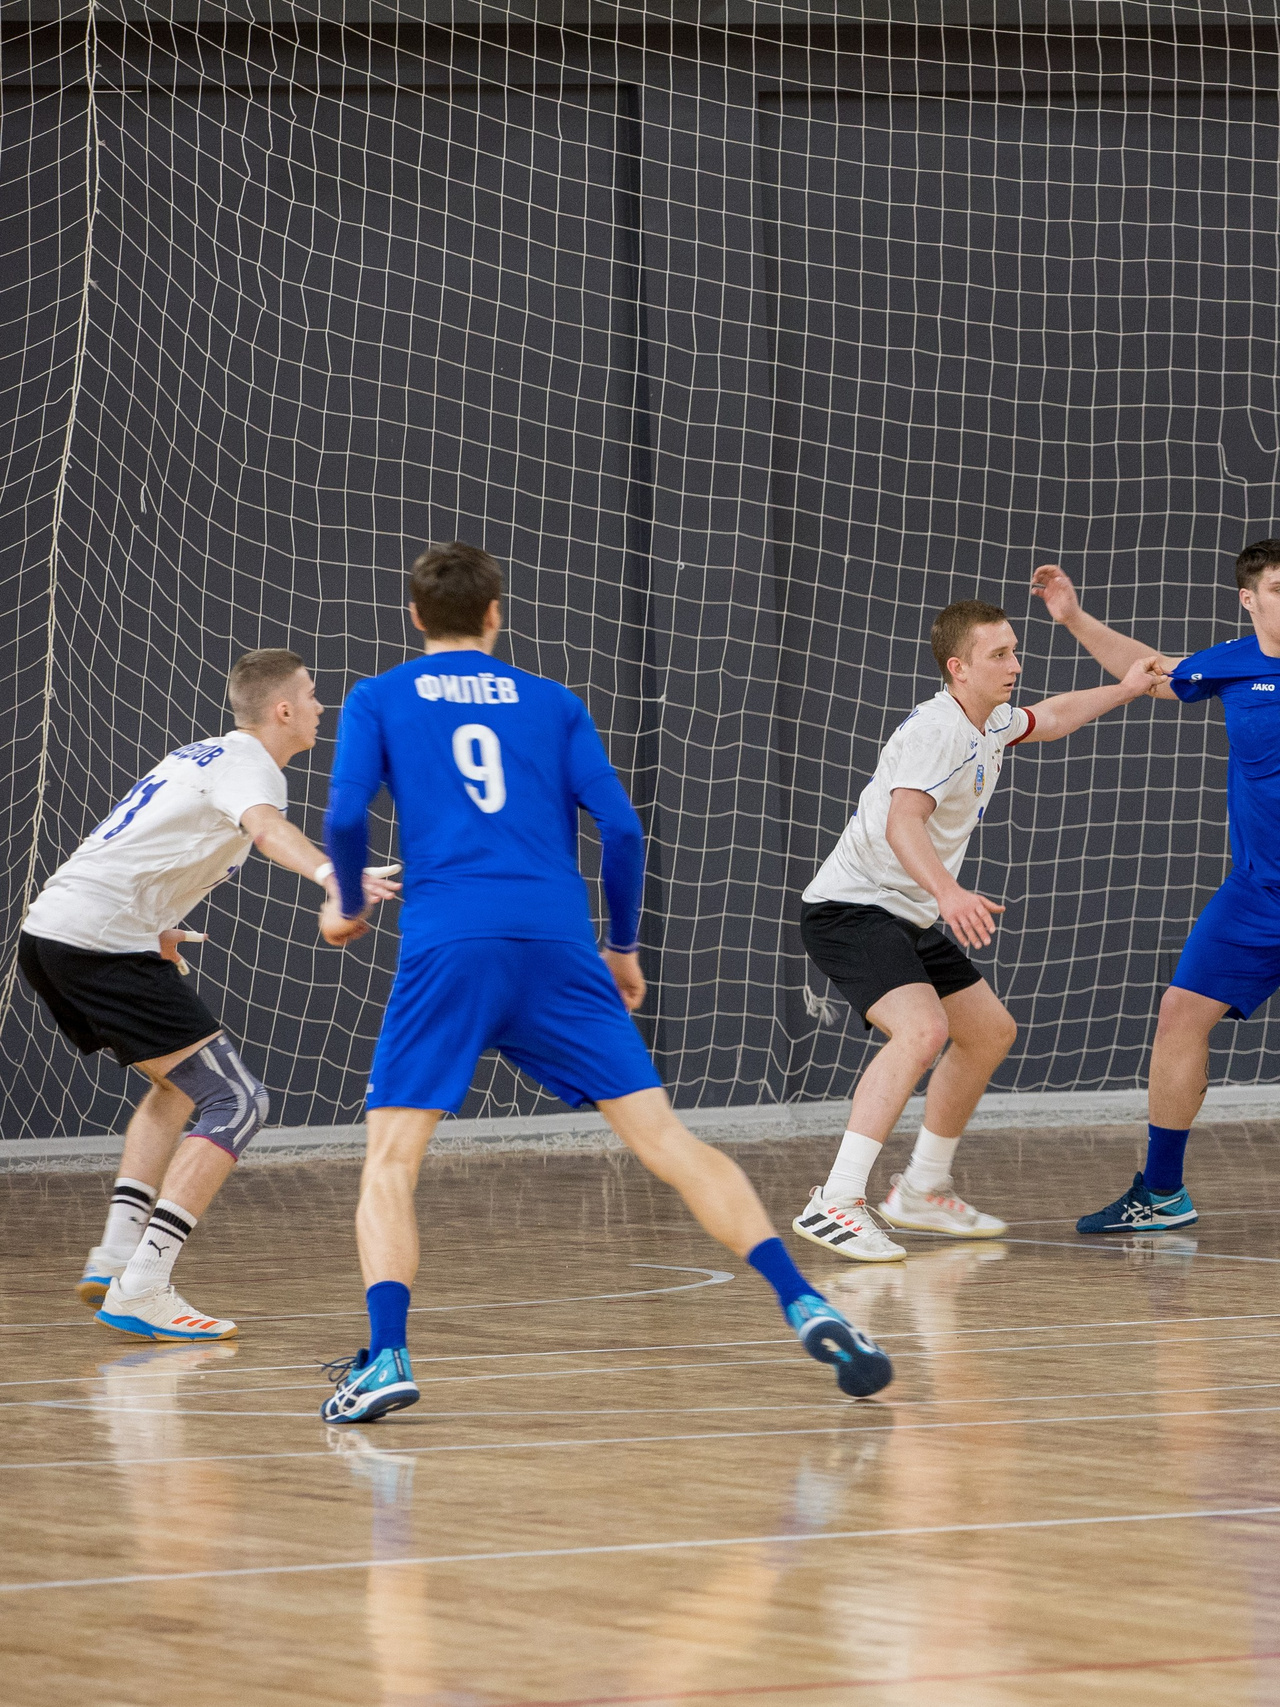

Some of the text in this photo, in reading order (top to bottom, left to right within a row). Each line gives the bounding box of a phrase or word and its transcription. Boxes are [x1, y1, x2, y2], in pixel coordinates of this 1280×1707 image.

[414, 672, 520, 705] ФИЛЁВ
[1251, 683, 1275, 692] JAKO
[451, 723, 507, 814] 9
